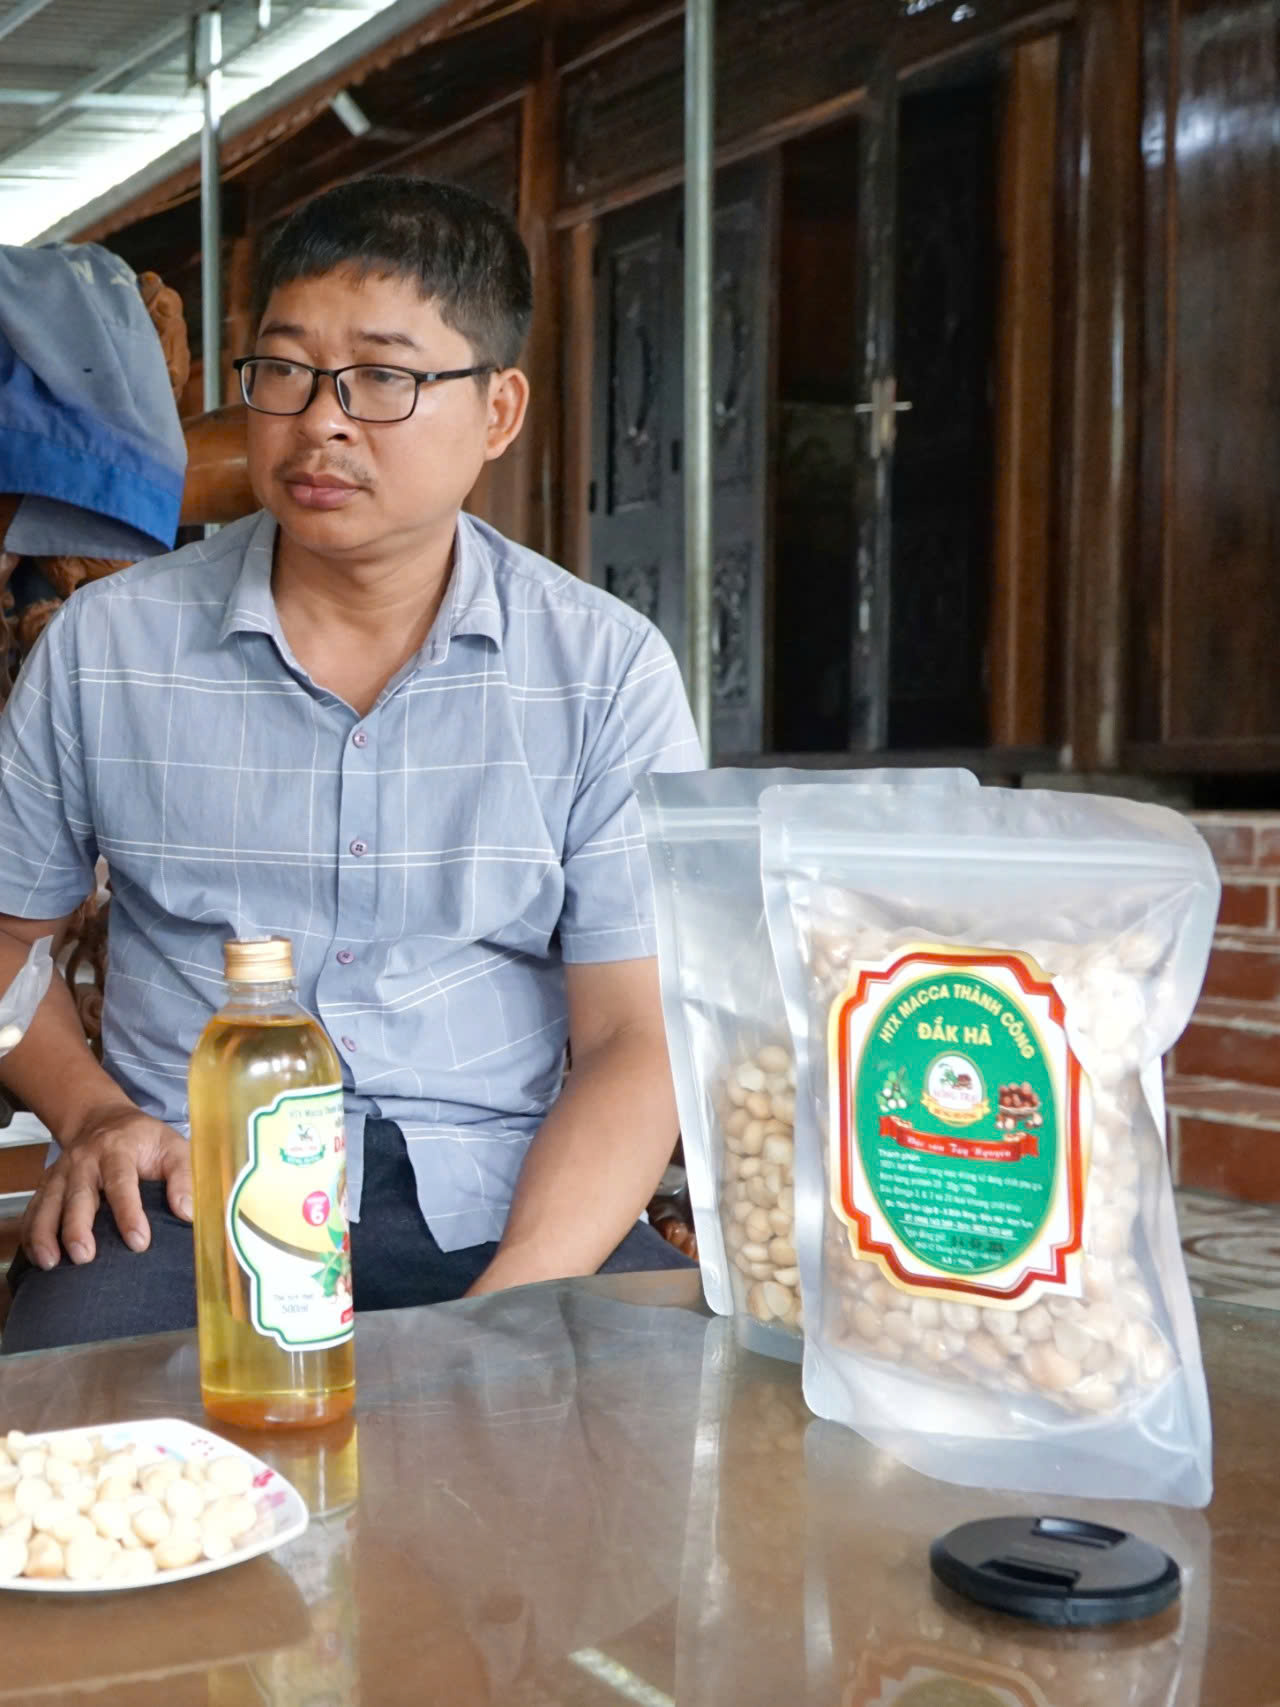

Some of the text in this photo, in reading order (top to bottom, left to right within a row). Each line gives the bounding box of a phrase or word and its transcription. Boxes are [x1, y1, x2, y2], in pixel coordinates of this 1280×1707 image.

[879, 983, 1035, 1059] HTX MACCA THÀNH CÔNG
[963, 1023, 992, 1046] HÀ
[310, 1204, 325, 1225] 6
